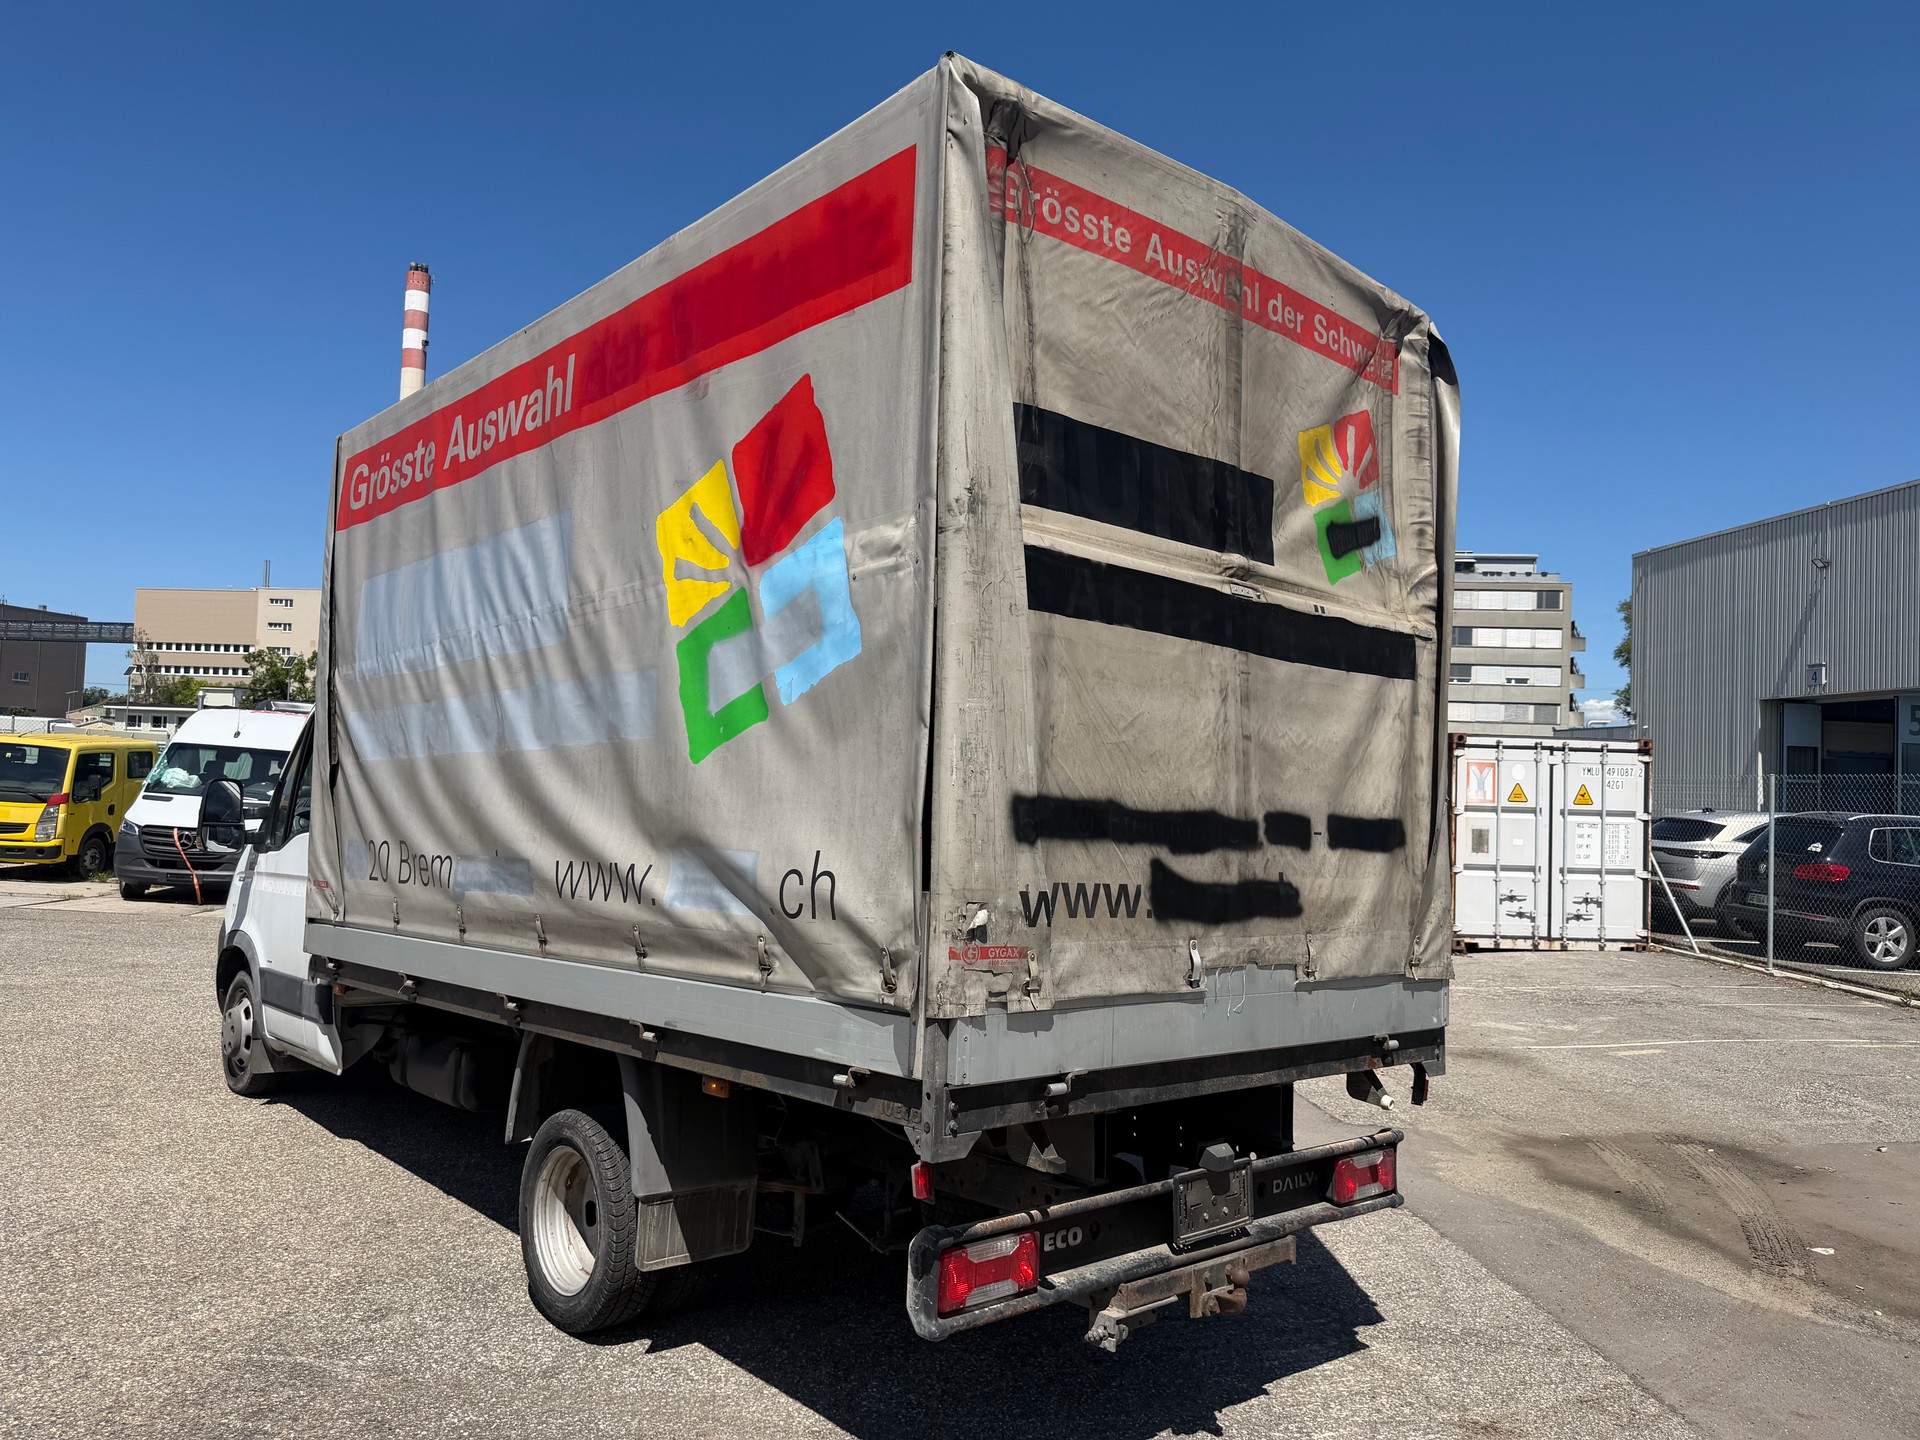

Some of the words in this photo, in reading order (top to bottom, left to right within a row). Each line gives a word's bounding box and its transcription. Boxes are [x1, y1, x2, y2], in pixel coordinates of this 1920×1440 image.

[1267, 292, 1304, 334] der
[1313, 313, 1393, 380] Schwez
[350, 438, 436, 510] Grösste
[443, 352, 576, 470] Auswahl
[1811, 671, 1818, 684] 4
[1582, 767, 1600, 776] YMLU
[1606, 767, 1634, 777] 491087
[1638, 768, 1644, 777] 2
[988, 947, 1019, 958] GYGAX
[1043, 1226, 1083, 1252] ECO
